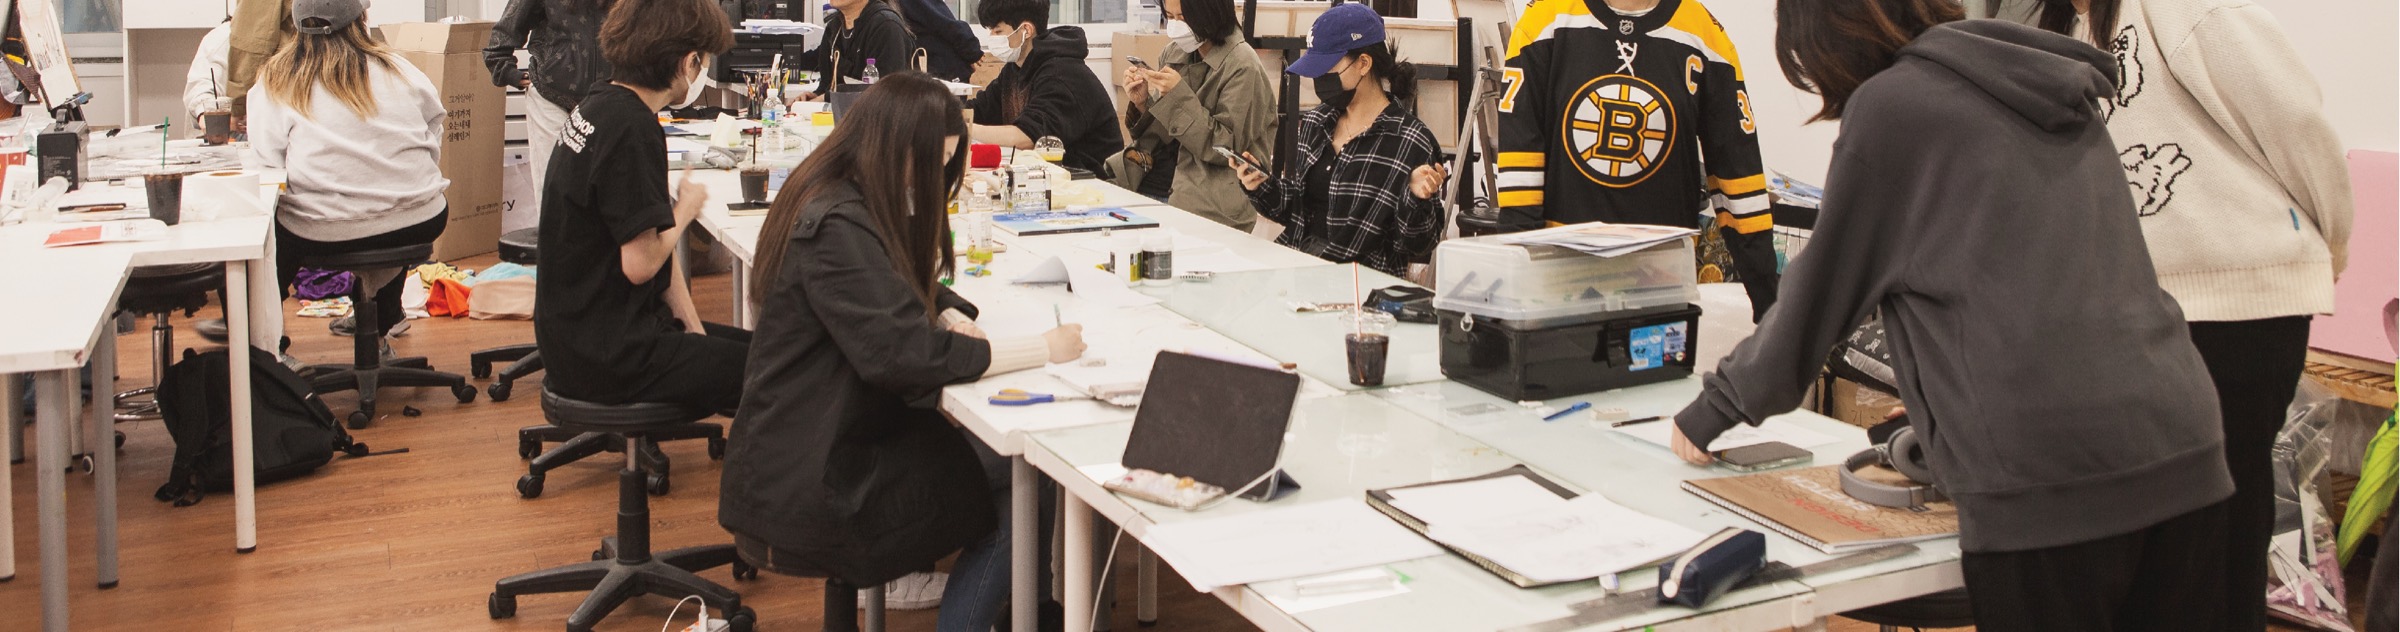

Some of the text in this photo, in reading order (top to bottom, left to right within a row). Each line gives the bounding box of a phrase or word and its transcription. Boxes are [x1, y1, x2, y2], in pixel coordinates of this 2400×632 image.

[1498, 66, 1524, 113] 7
[1685, 54, 1704, 95] C
[1591, 97, 1649, 163] B
[1736, 89, 1756, 135] 3
[1783, 476, 1876, 511] SKETCH
[1786, 498, 1880, 532] DESIGN
